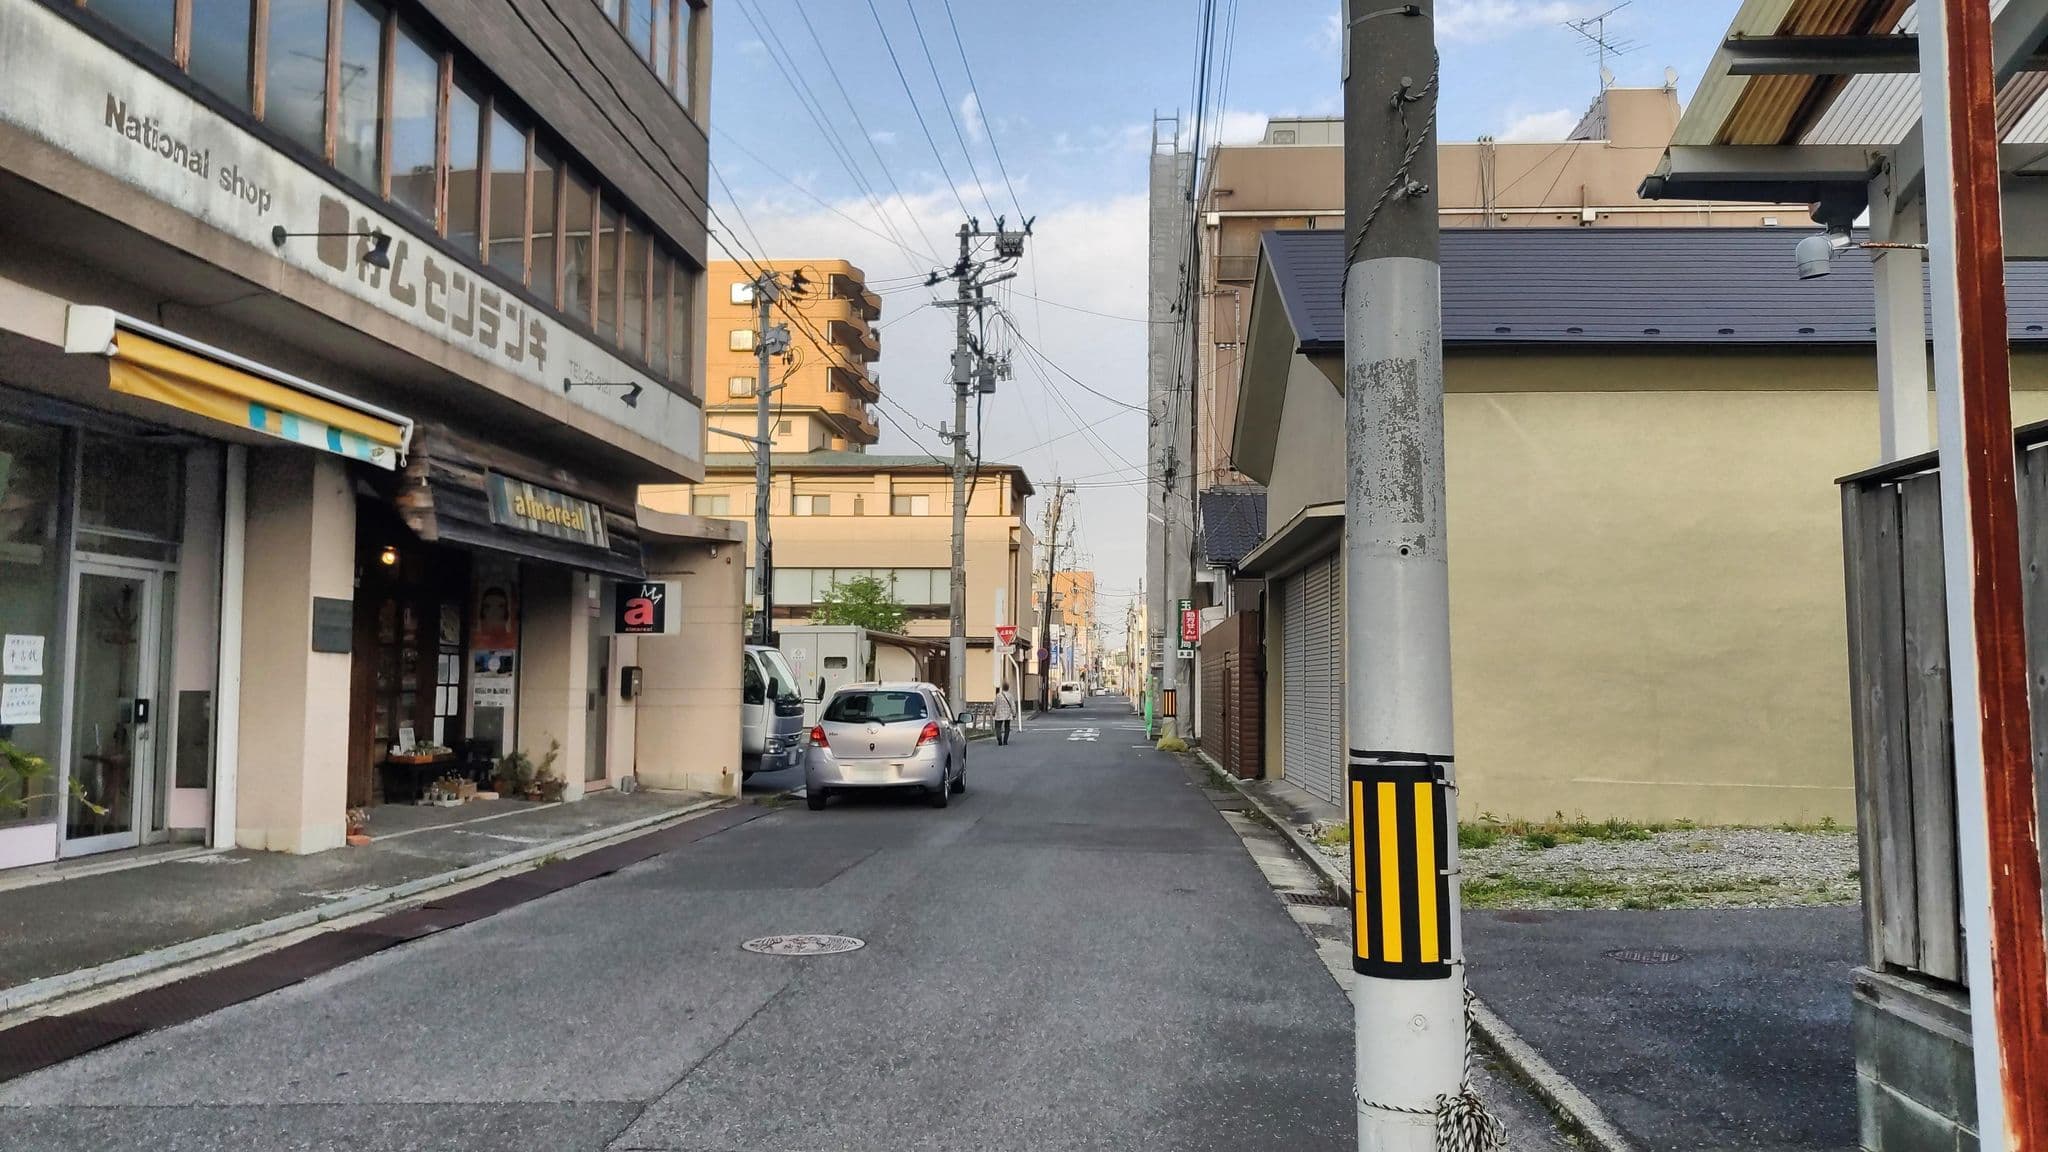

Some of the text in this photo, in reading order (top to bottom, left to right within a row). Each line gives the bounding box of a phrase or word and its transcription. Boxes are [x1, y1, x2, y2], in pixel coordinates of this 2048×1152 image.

[104, 92, 272, 217] National shop
[513, 494, 586, 532] almareal
[624, 597, 654, 625] a
